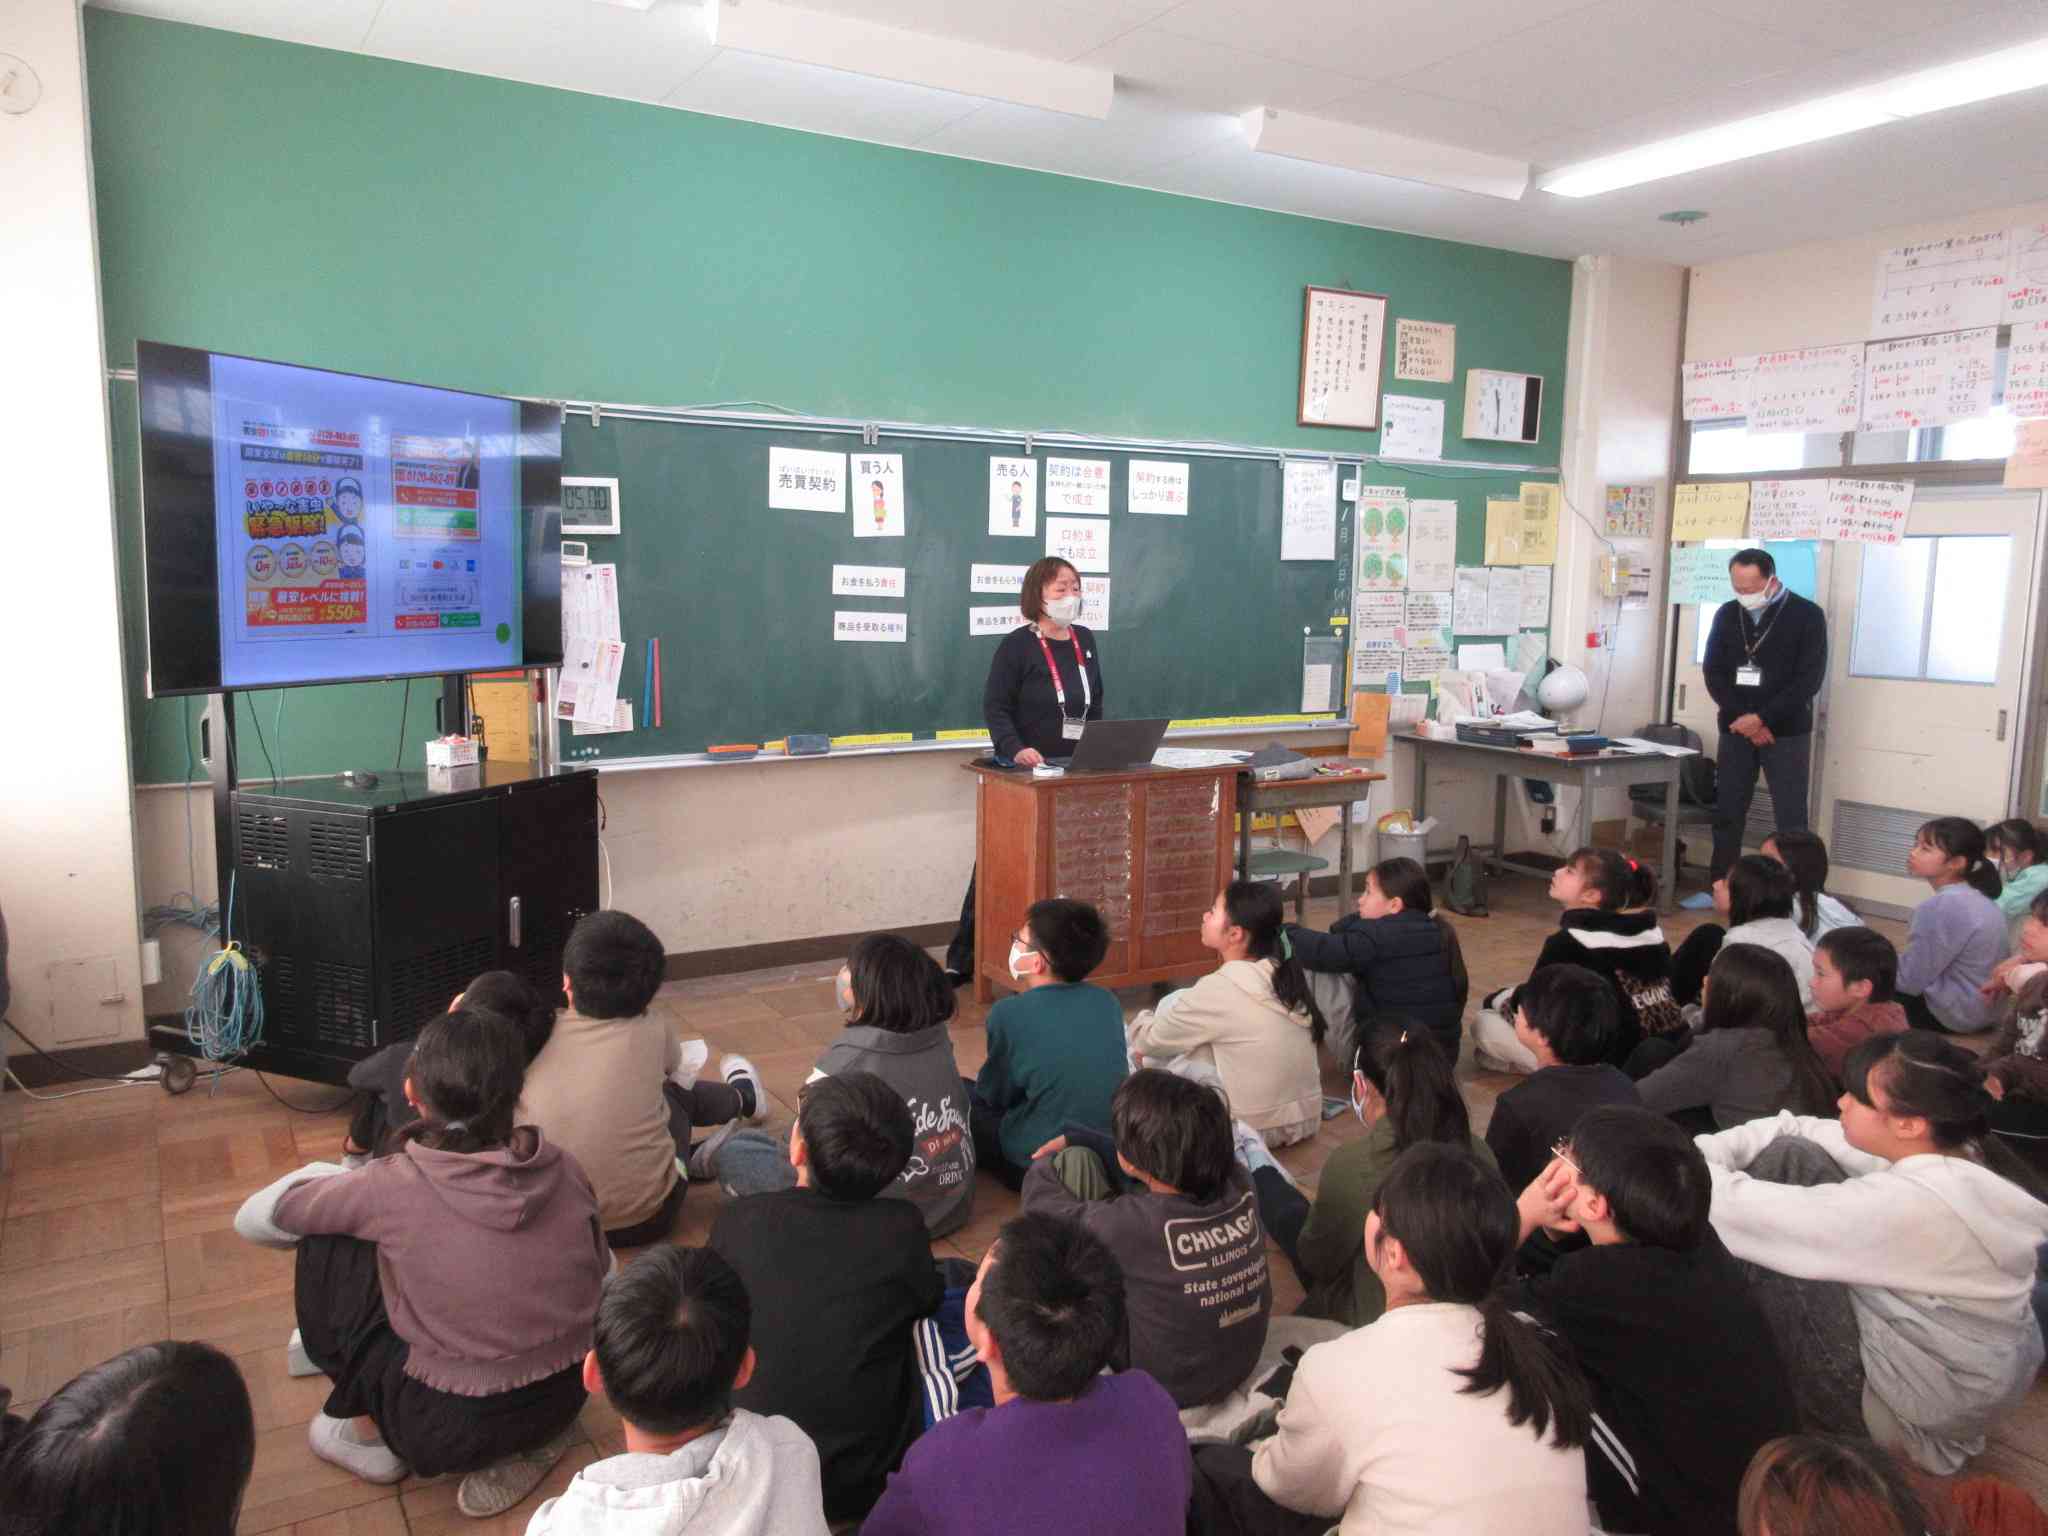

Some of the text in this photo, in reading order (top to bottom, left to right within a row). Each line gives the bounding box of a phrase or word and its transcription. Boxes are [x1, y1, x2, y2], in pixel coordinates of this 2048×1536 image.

[860, 460, 894, 474] 買う人
[996, 464, 1030, 478] 売る人
[779, 474, 837, 492] 売買契約
[1063, 493, 1095, 506] で成立
[1061, 529, 1095, 542] 口約束
[1057, 547, 1097, 561] でも成立
[841, 576, 897, 589] お金を払う責任
[1183, 1280, 1218, 1295] State
[1200, 1283, 1245, 1308] national
